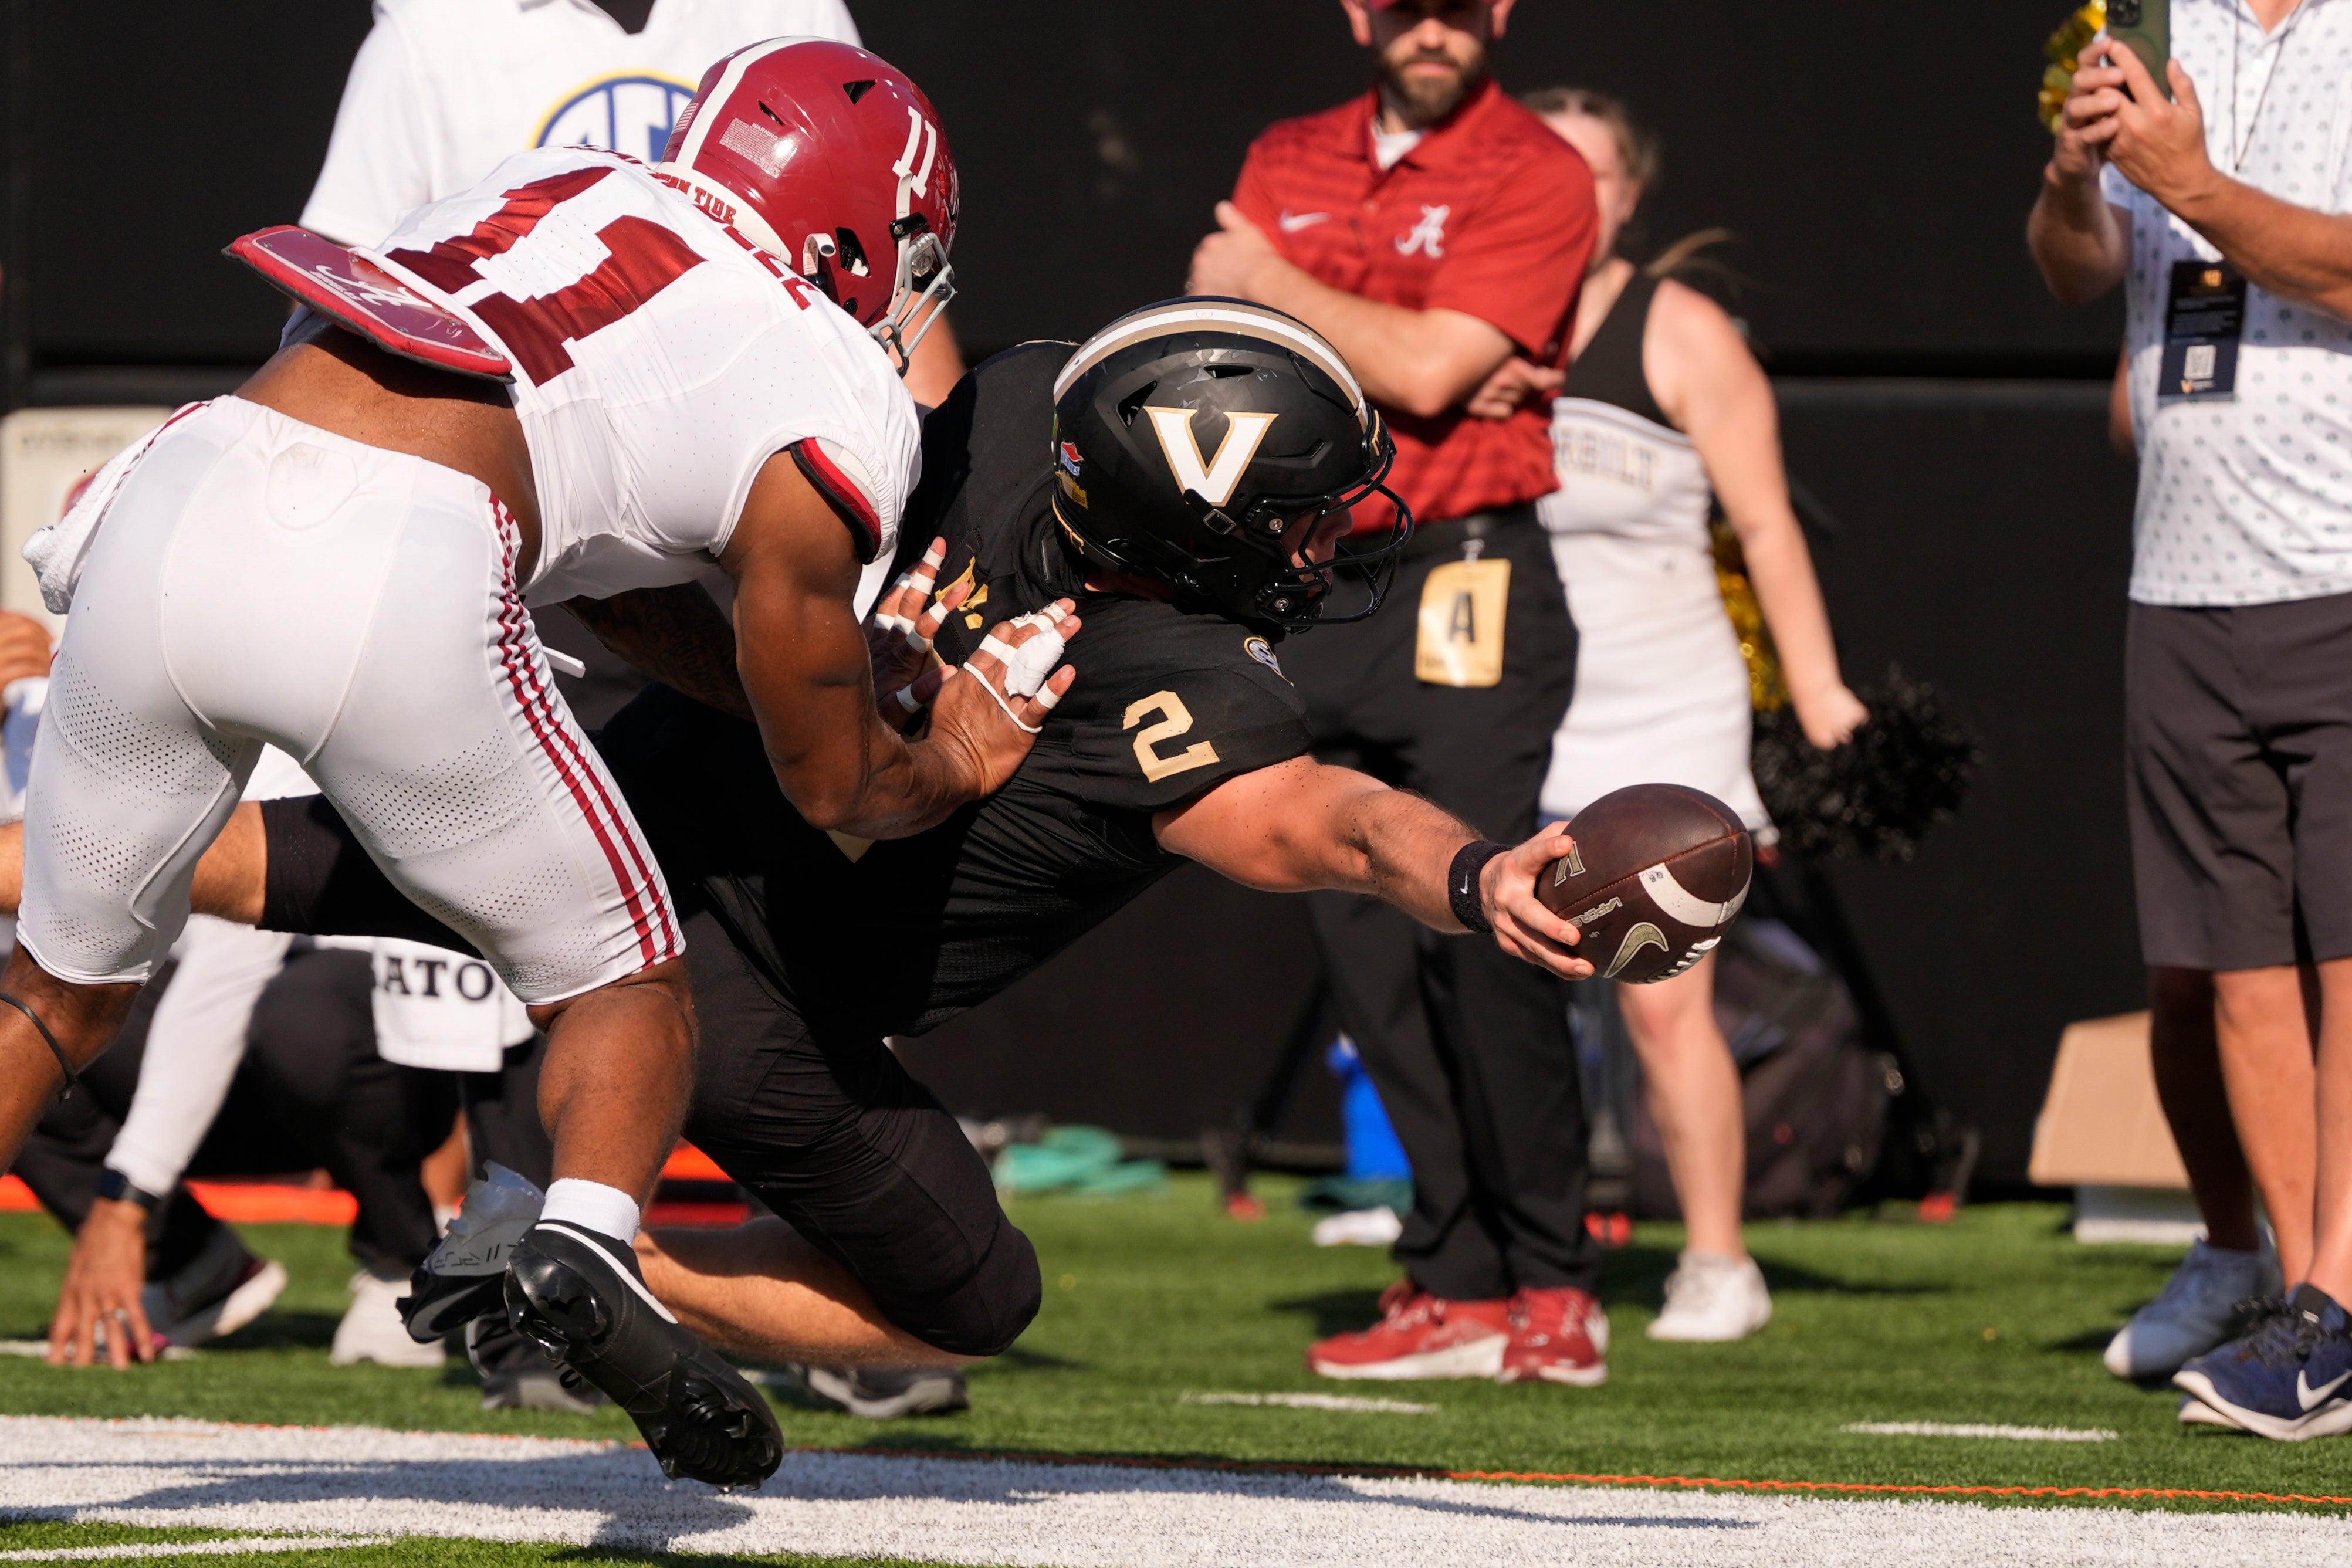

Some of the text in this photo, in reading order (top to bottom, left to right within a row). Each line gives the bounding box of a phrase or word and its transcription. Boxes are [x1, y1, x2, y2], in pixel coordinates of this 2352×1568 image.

[752, 121, 779, 141] WARNING
[892, 105, 937, 199] 11
[694, 186, 737, 226] TIDE
[1143, 405, 1280, 507] V
[1448, 591, 1476, 644] A
[1122, 690, 1220, 783] 2
